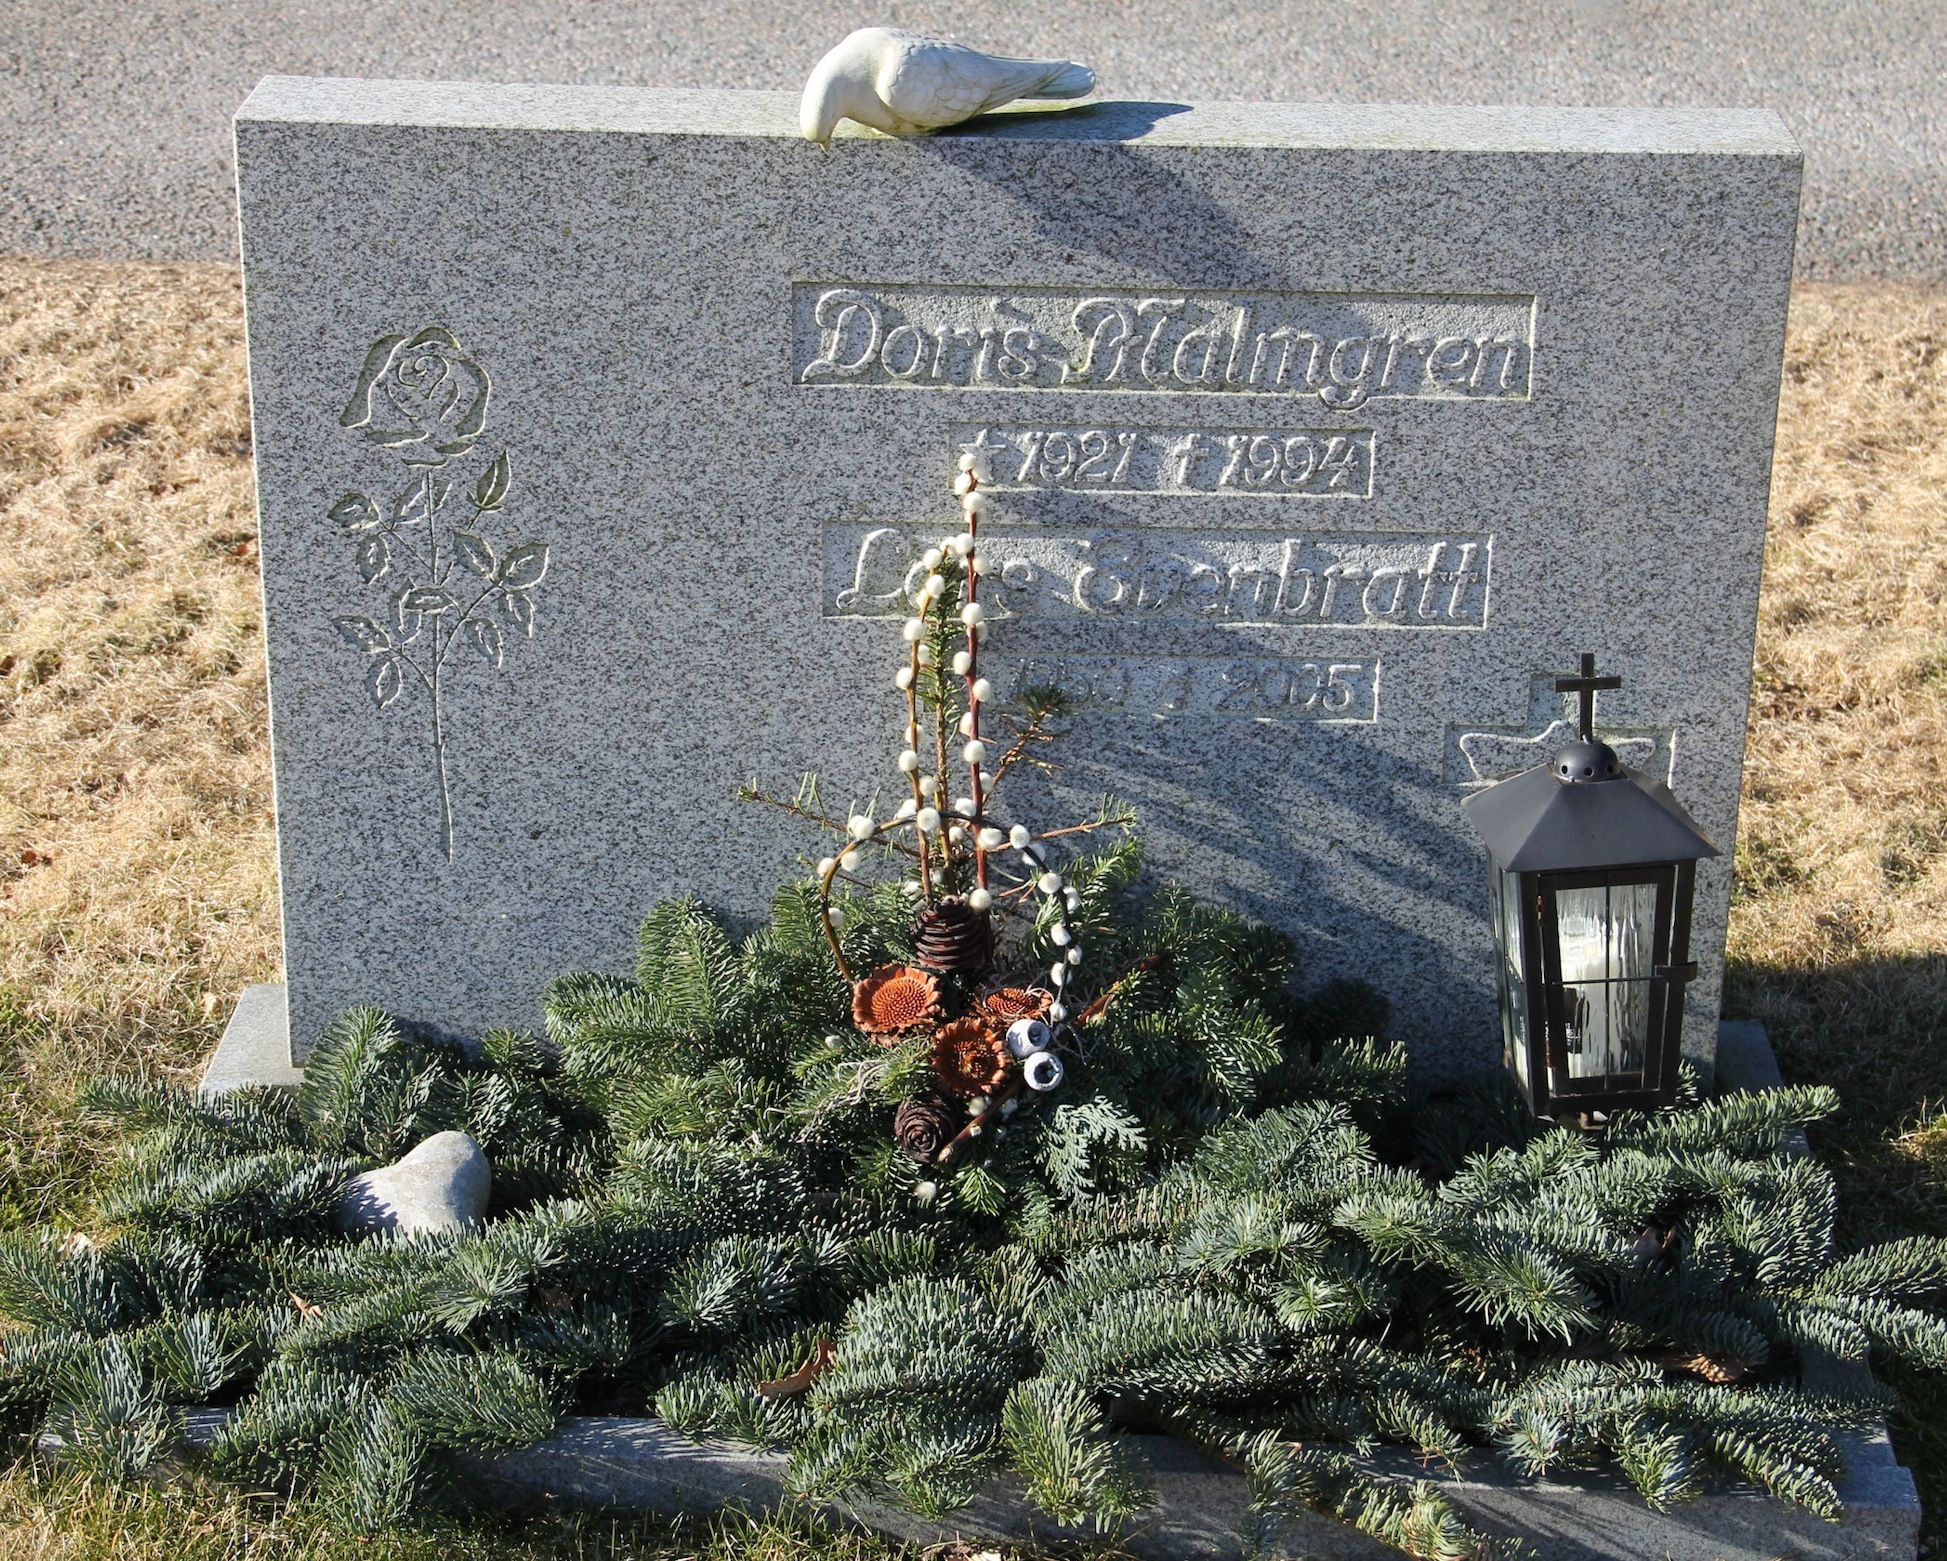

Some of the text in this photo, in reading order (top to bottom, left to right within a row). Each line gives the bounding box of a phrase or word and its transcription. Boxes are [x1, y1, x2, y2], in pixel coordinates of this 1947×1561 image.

[801, 287, 1521, 411] Doris Malmgren
[1017, 430, 1360, 488] 1921 1994
[836, 527, 1039, 614] Ls
[1210, 660, 1363, 712] 2005
